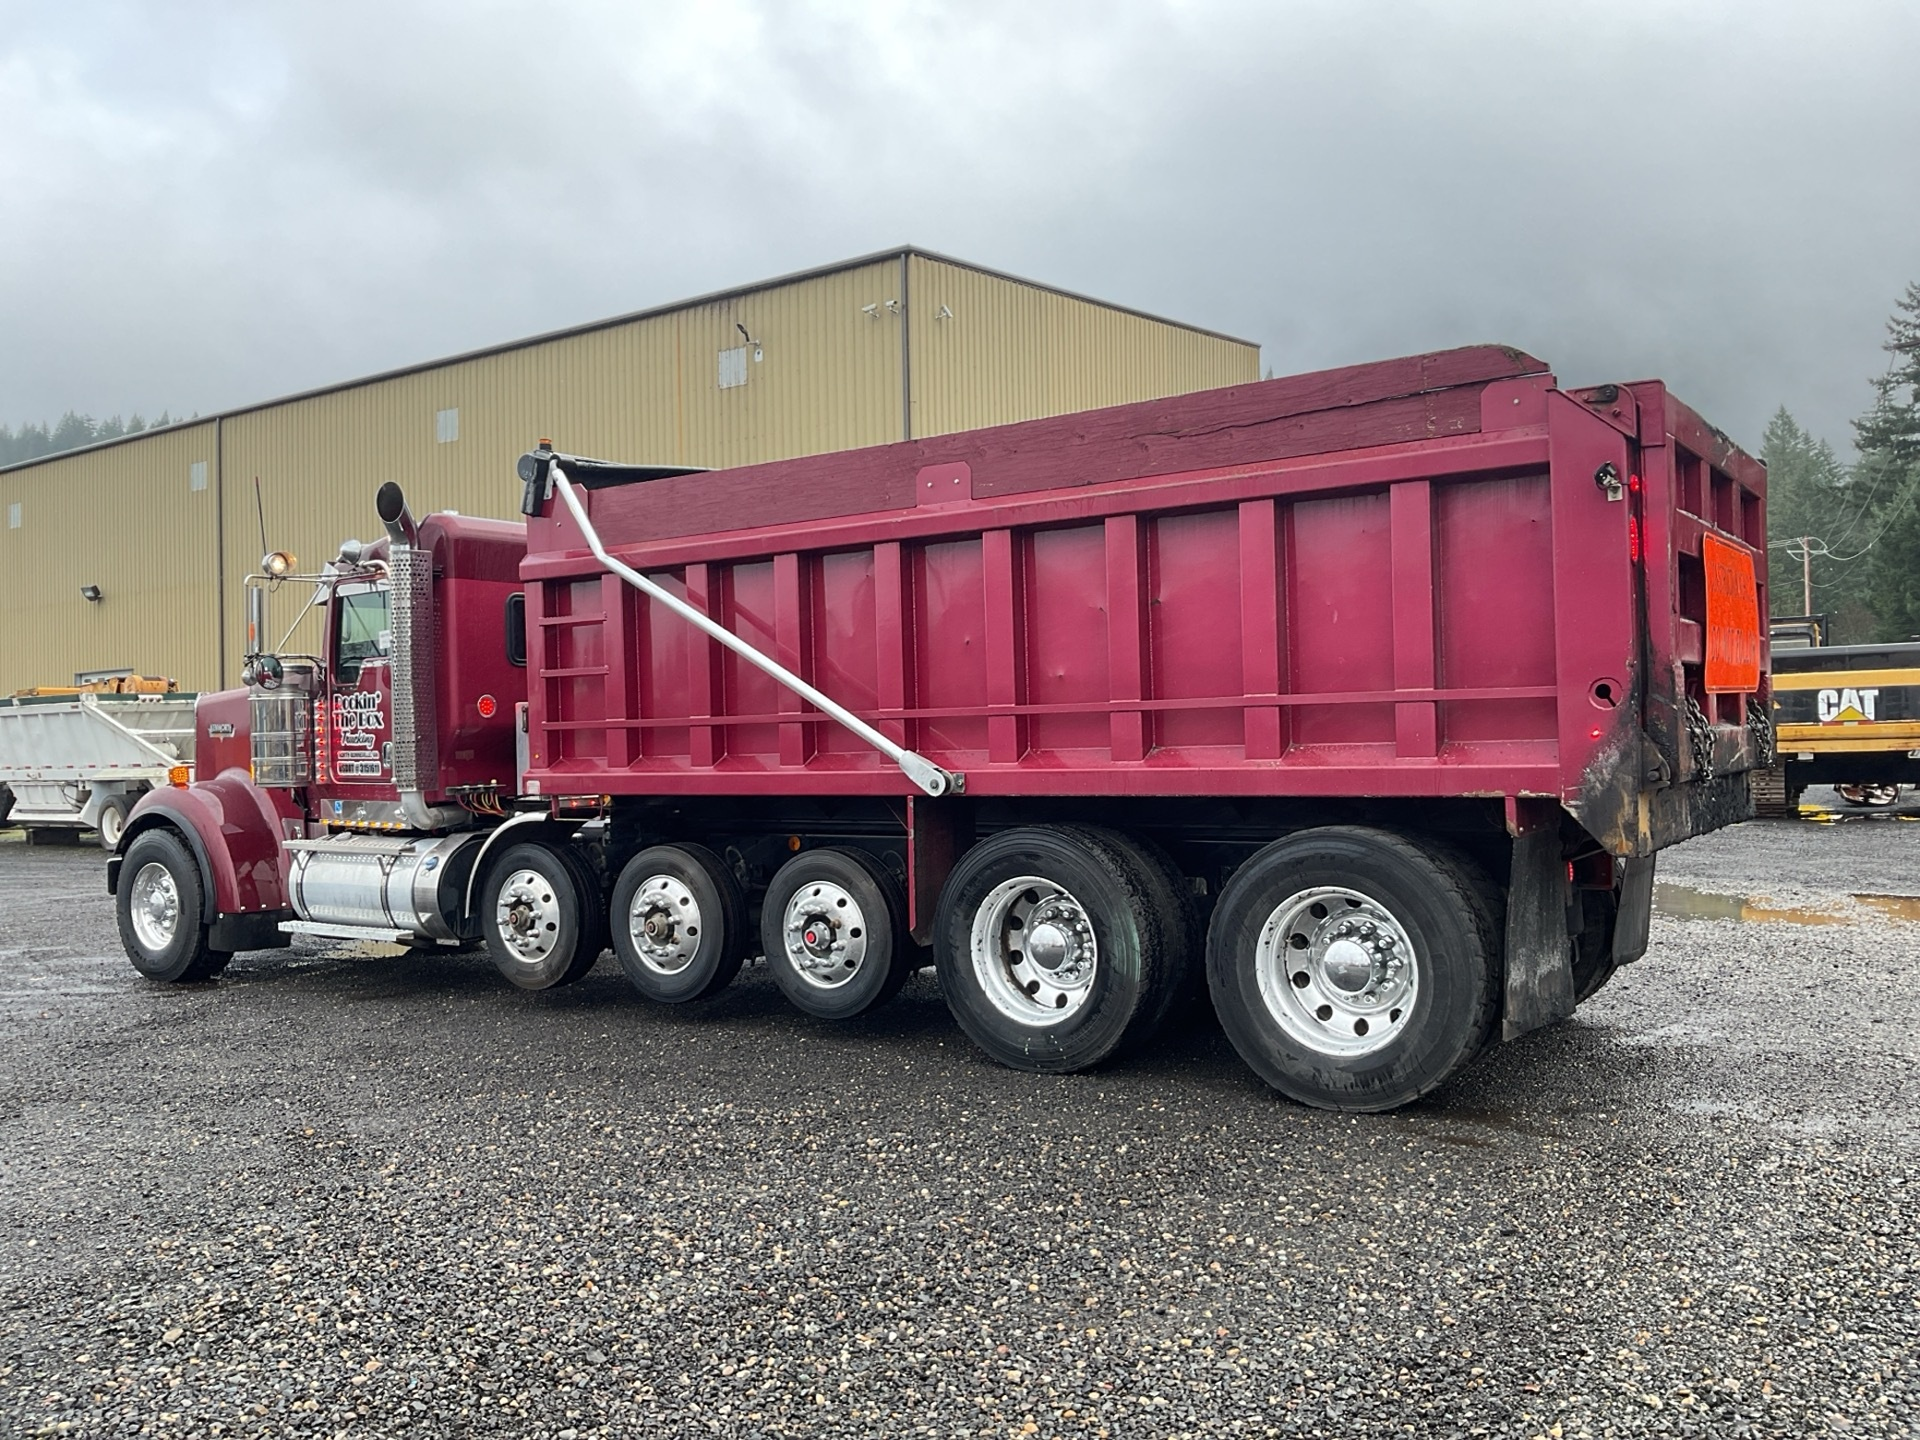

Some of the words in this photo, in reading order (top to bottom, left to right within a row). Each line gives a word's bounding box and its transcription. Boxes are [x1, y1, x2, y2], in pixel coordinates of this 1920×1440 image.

[334, 692, 381, 710] Rockin'
[1817, 688, 1879, 721] CAT
[333, 712, 355, 729] The
[358, 711, 384, 728] Box
[341, 730, 375, 748] Trucking
